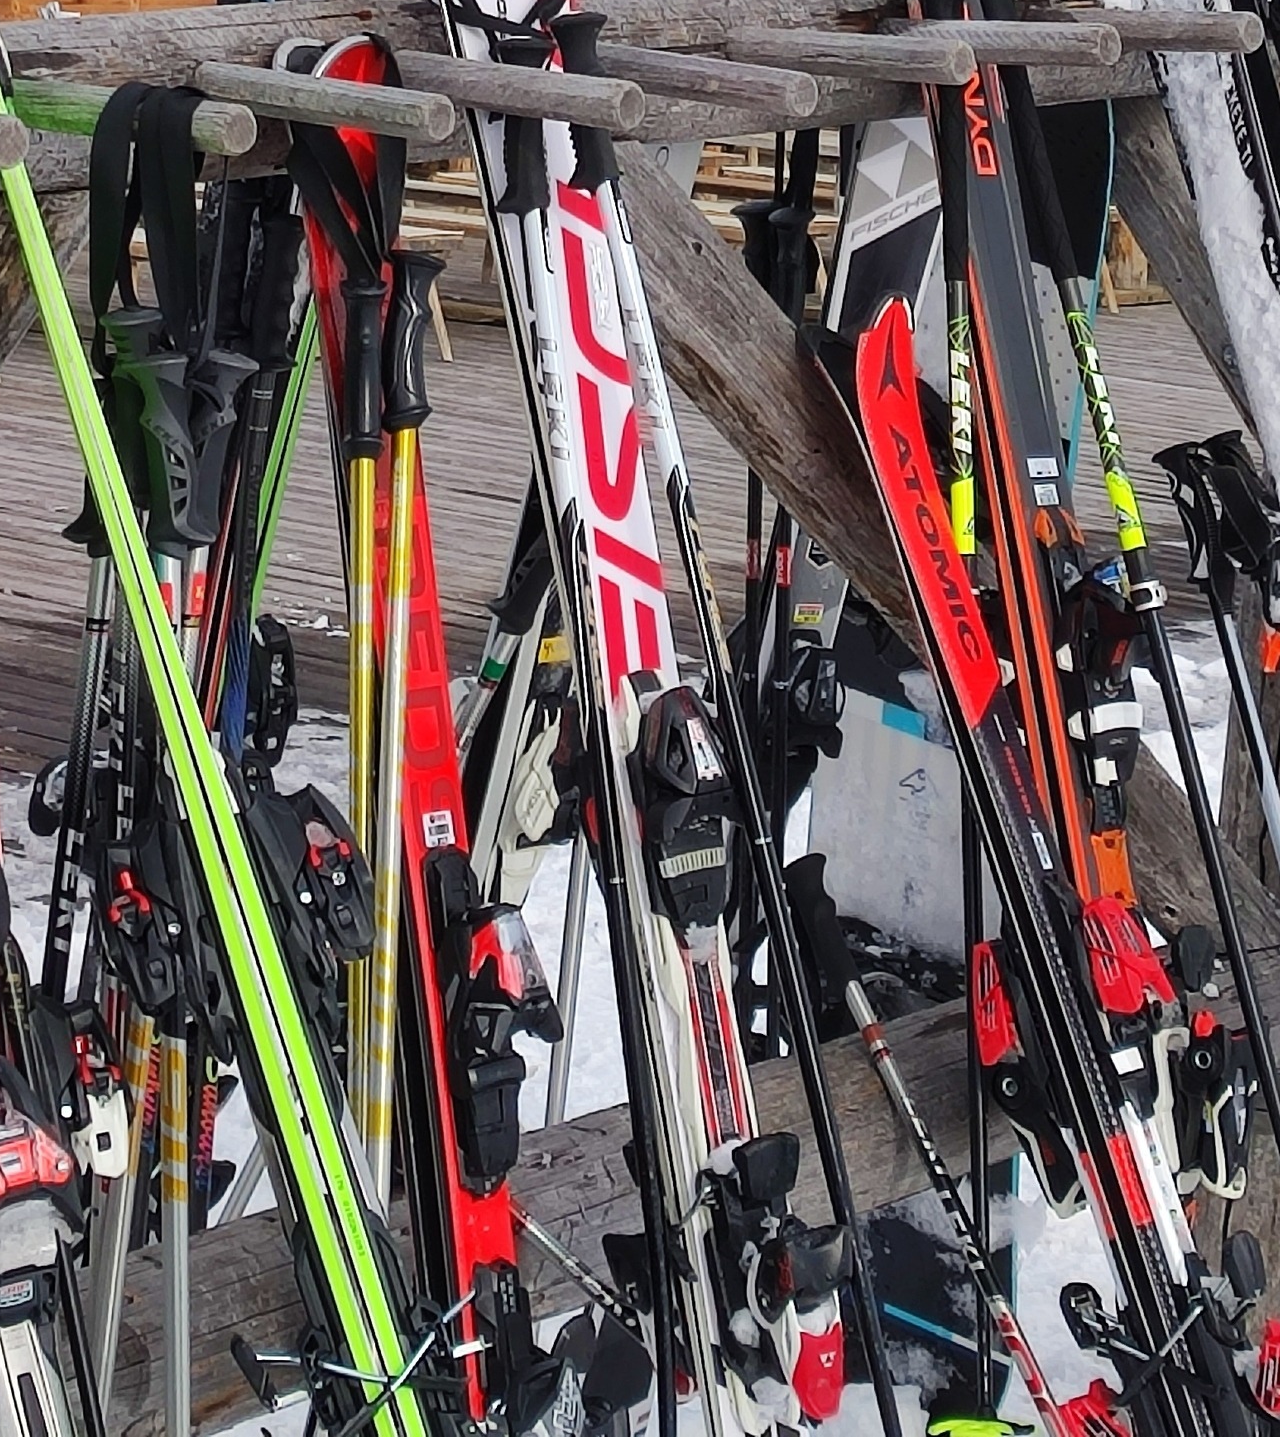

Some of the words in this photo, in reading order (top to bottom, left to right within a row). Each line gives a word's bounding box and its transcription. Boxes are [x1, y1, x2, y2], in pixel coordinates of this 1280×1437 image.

[537, 336, 570, 461] LEKI
[624, 308, 664, 430] LEKI
[949, 348, 973, 456] LEKI
[1084, 345, 1120, 448] LEKI
[887, 424, 984, 664] ATOMIC
[53, 828, 85, 953] LEKI
